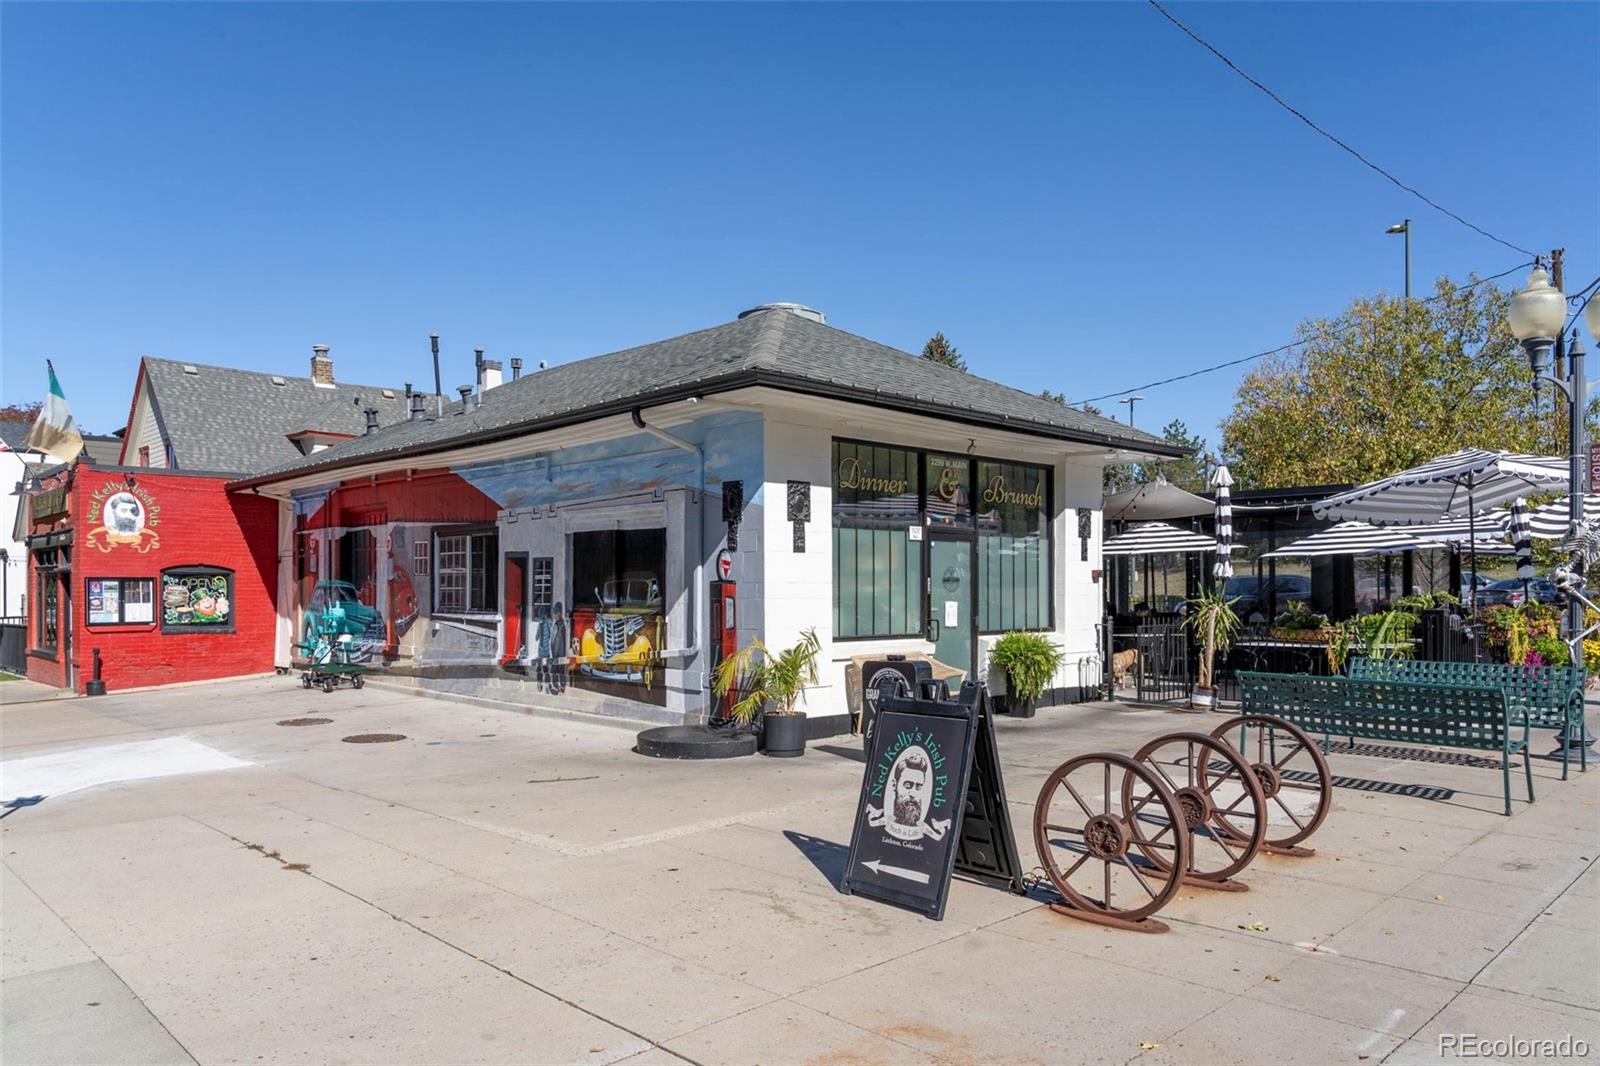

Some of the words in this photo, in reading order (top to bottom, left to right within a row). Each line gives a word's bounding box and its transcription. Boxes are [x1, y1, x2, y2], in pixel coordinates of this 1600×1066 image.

[839, 457, 908, 494] Dinner
[940, 468, 960, 499] &
[983, 475, 1044, 507] Brunch
[87, 501, 100, 524] Ned
[133, 482, 156, 506] Irish
[149, 505, 162, 527] Pub
[180, 577, 214, 590] OPEN
[884, 726, 922, 761] Kelly's
[924, 732, 946, 770] Irish
[871, 764, 889, 797] Ned
[933, 775, 948, 808] Pub
[902, 841, 924, 851] Colorado
